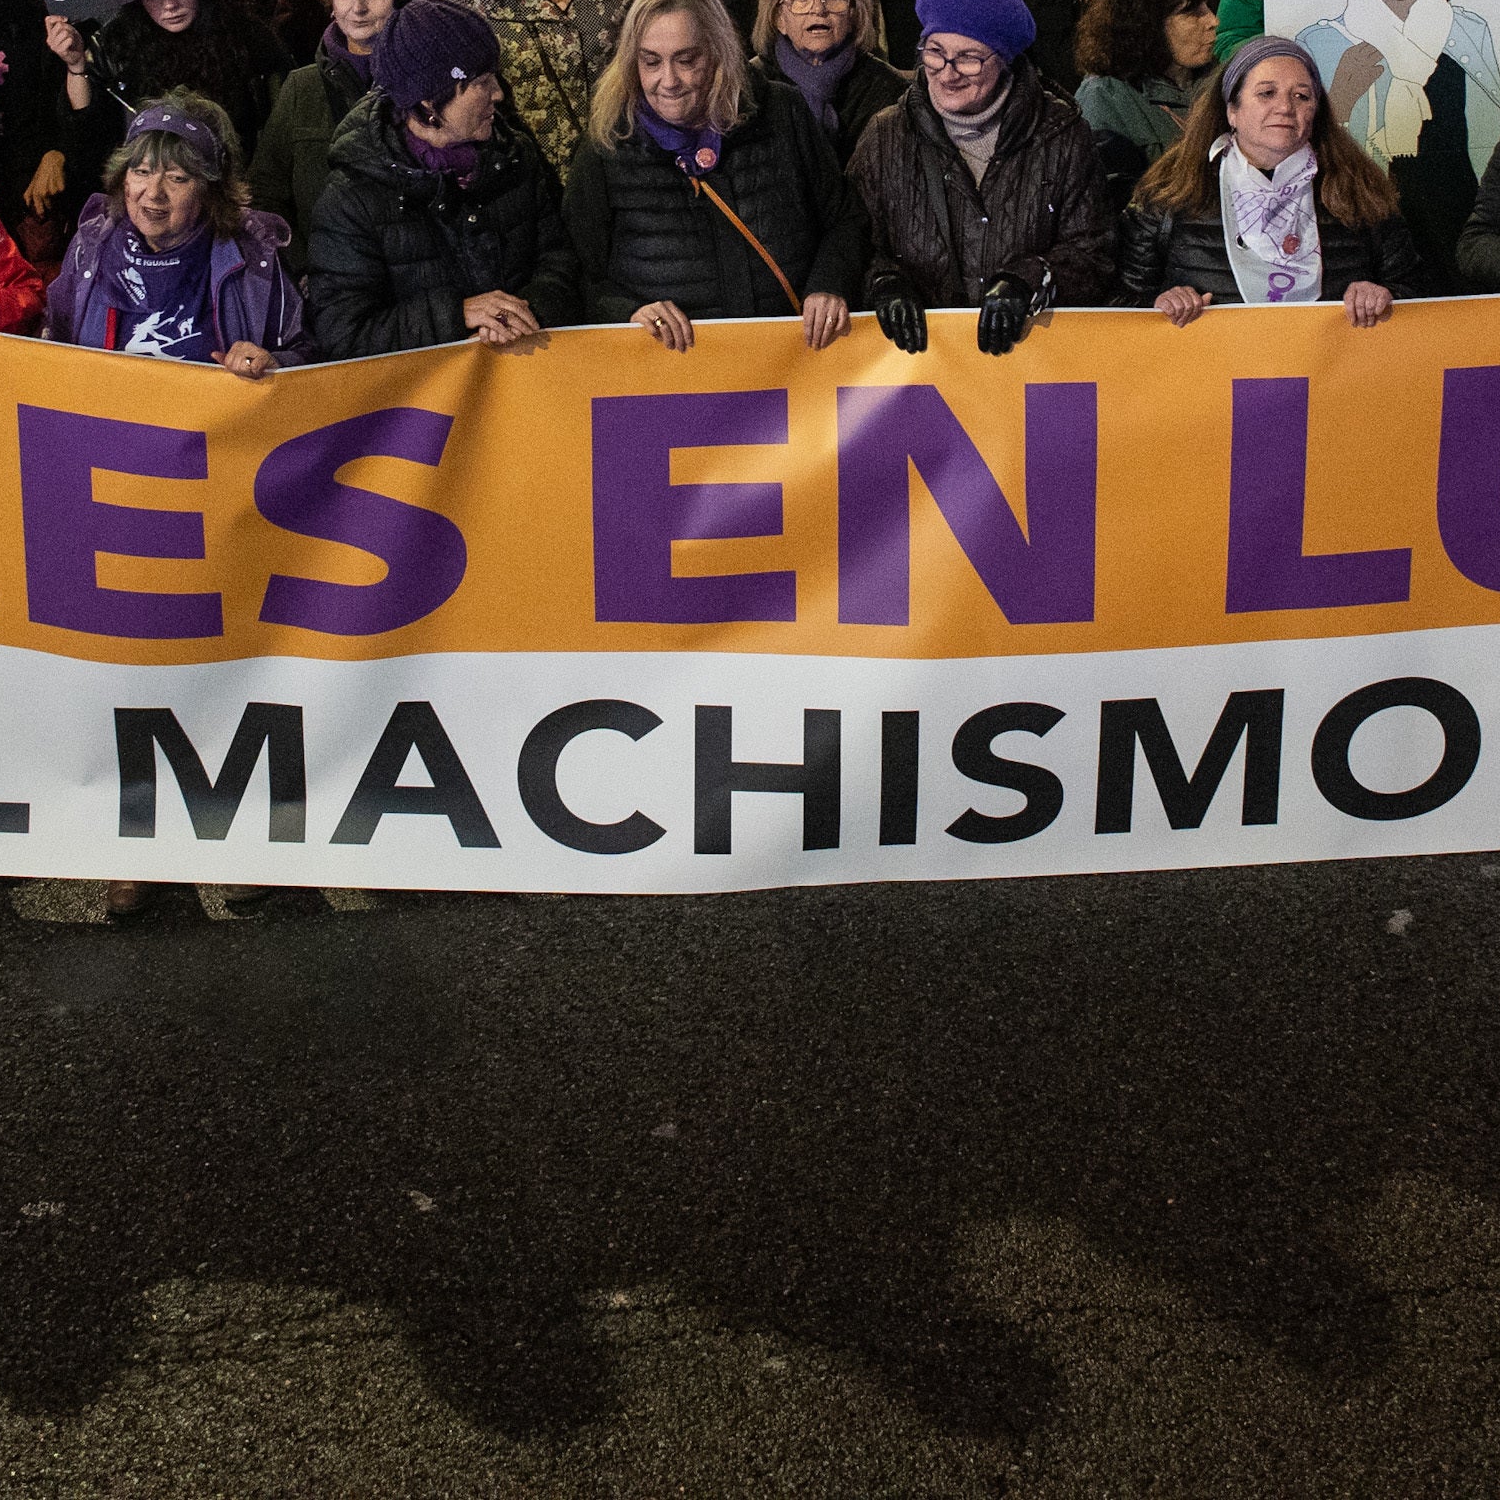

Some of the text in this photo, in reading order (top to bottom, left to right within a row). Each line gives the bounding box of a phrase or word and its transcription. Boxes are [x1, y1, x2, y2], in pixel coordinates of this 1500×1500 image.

[143, 256, 181, 268] IGUALES
[590, 381, 1099, 627] EN
[112, 674, 1482, 856] MACHISMO
